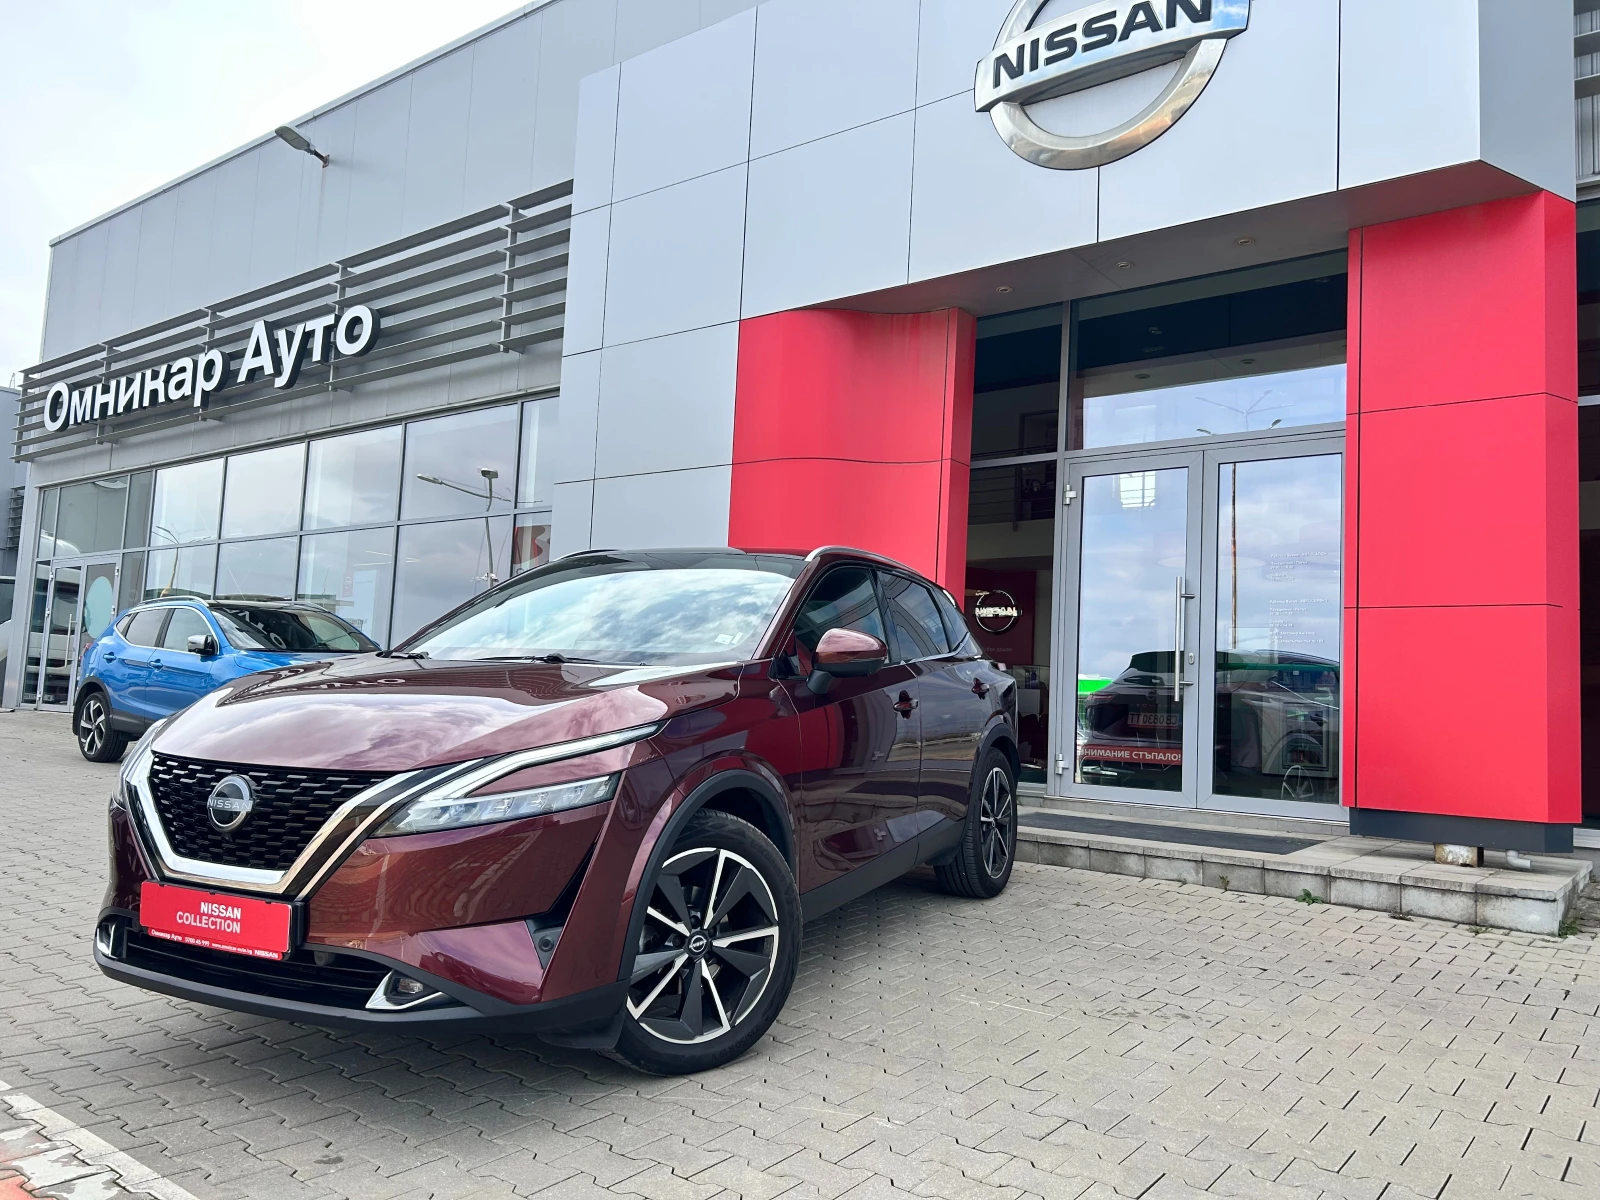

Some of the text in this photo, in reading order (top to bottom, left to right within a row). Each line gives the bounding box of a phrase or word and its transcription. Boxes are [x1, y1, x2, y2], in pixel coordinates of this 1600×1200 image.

[993, 0, 1212, 89] NISSAN
[44, 304, 376, 432] Омникар Ауто
[1132, 751, 1182, 761] СТЪПАЛО!
[208, 799, 251, 810] NISSAN
[200, 902, 242, 919] NISSAN
[176, 911, 241, 934] COLLECTION
[254, 949, 279, 959] NISSAN
